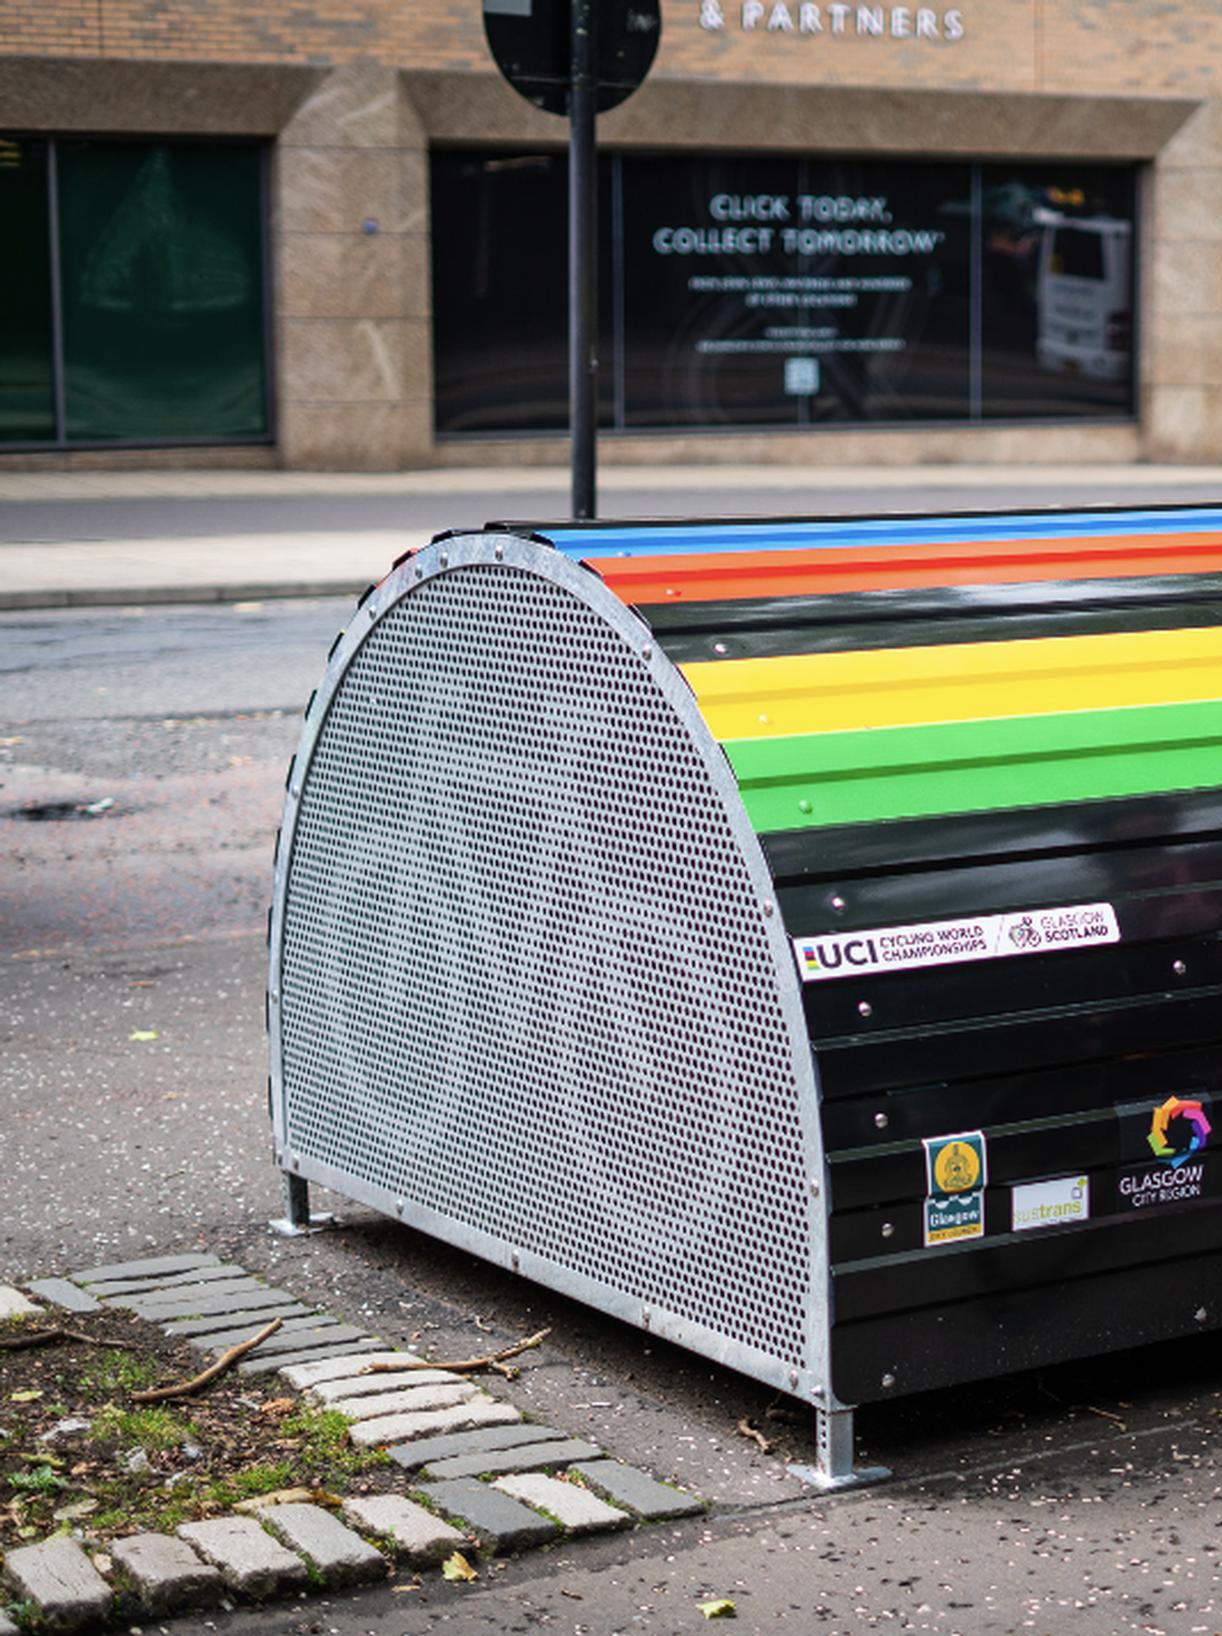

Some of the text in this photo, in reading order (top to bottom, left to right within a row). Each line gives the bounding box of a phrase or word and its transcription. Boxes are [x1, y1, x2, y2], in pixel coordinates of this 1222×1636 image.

[699, 0, 965, 40] & PARTNERS
[710, 194, 790, 221] CLICK
[652, 227, 774, 255] COLLECT
[1040, 911, 1103, 930] GLASGOW
[880, 925, 984, 948] CYCLING WORLD
[1045, 924, 1108, 943] SCOTLAND
[816, 939, 879, 969] UCI
[882, 939, 987, 962] CHAMPIONSHIPS
[1120, 1165, 1203, 1195] GLASGOW
[1132, 1184, 1201, 1207] CITY REGION
[930, 1210, 979, 1227] Glasgow
[1014, 1200, 1082, 1224] sustrans
